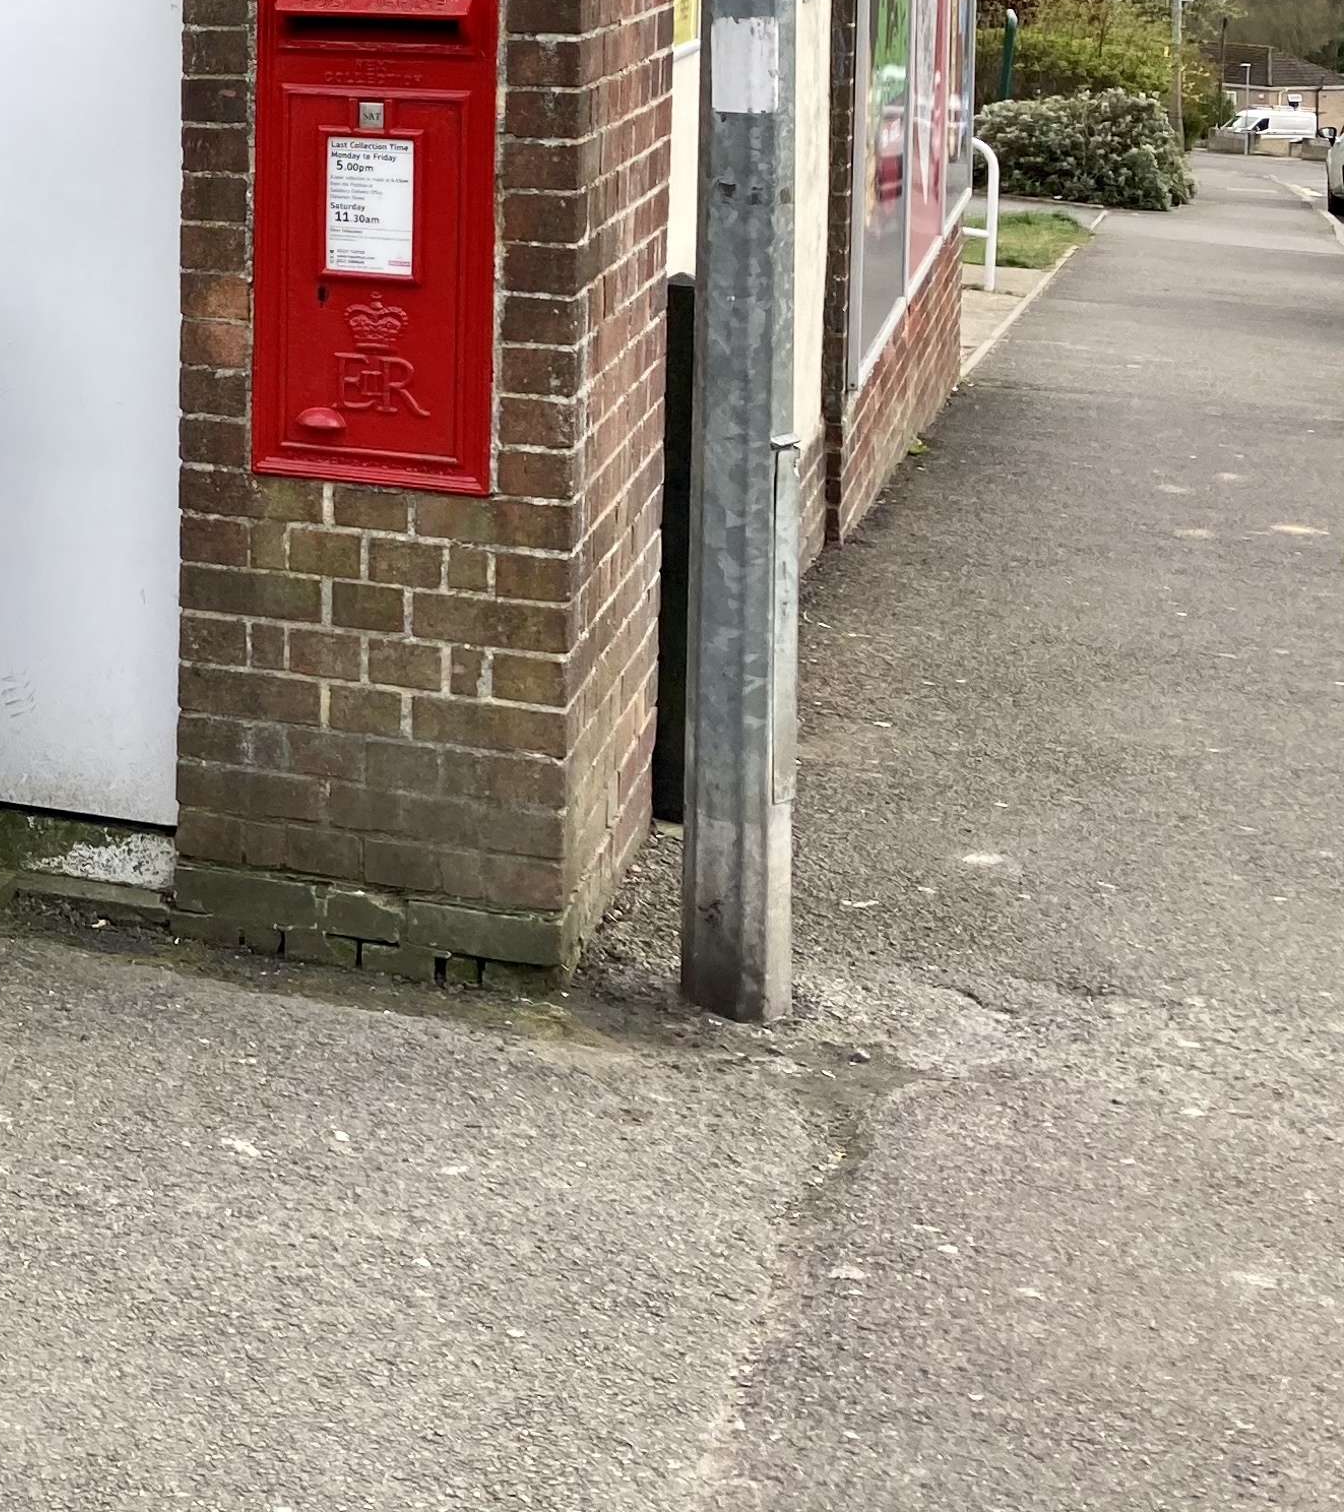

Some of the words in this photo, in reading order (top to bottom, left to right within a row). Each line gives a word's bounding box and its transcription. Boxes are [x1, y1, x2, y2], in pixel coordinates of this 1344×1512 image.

[363, 112, 381, 121] SAT
[350, 142, 387, 150] Collection
[331, 151, 360, 160] Monday
[373, 154, 396, 162] Friday
[336, 160, 373, 172] 5.00pm
[330, 202, 365, 211] Saturday
[335, 211, 379, 223] 11.30am
